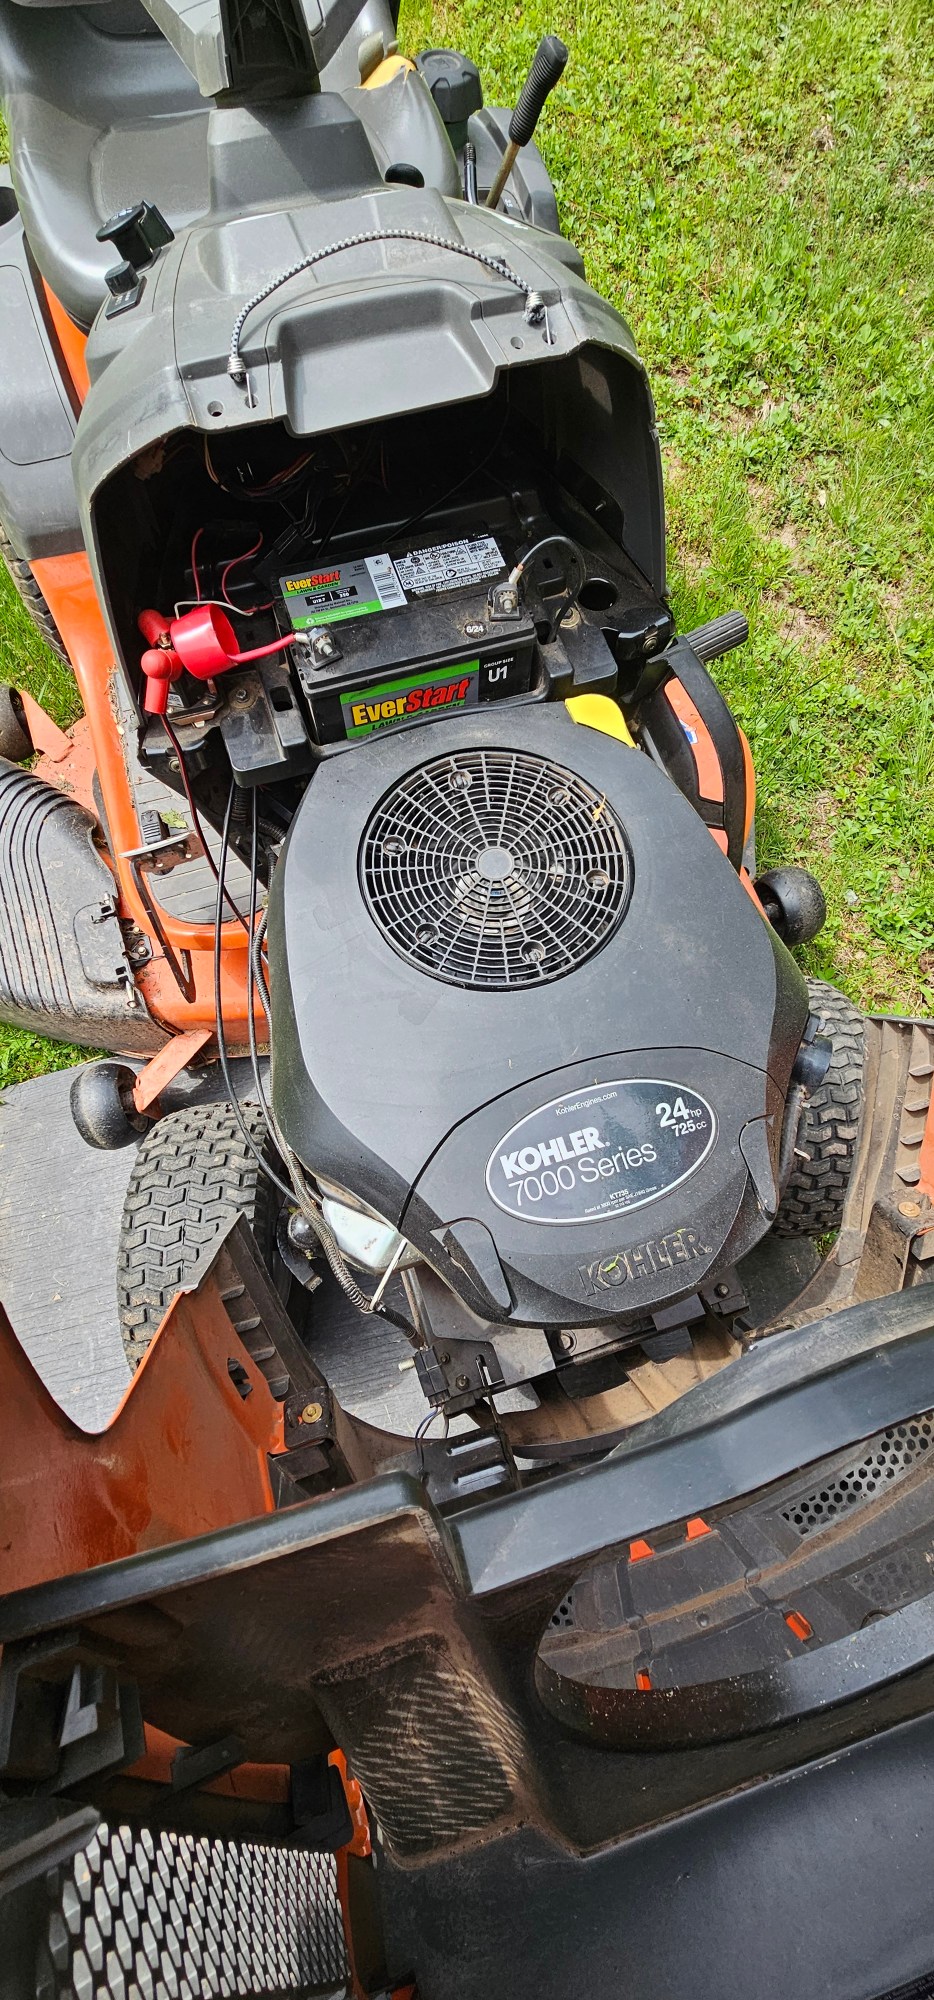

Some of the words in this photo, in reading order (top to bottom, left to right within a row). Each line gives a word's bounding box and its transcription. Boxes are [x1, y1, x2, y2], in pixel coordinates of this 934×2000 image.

[286, 570, 340, 591] EverStart
[466, 625, 484, 633] 6/24
[488, 666, 507, 682] U1
[351, 677, 472, 726] EverStart
[555, 1091, 618, 1116] KohlerEngines.com
[655, 1097, 690, 1128] 24
[690, 1108, 702, 1118] hp
[671, 1120, 696, 1137] 725
[696, 1121, 707, 1130] cc
[508, 1165, 576, 1206] 7000
[578, 1143, 657, 1183] Series
